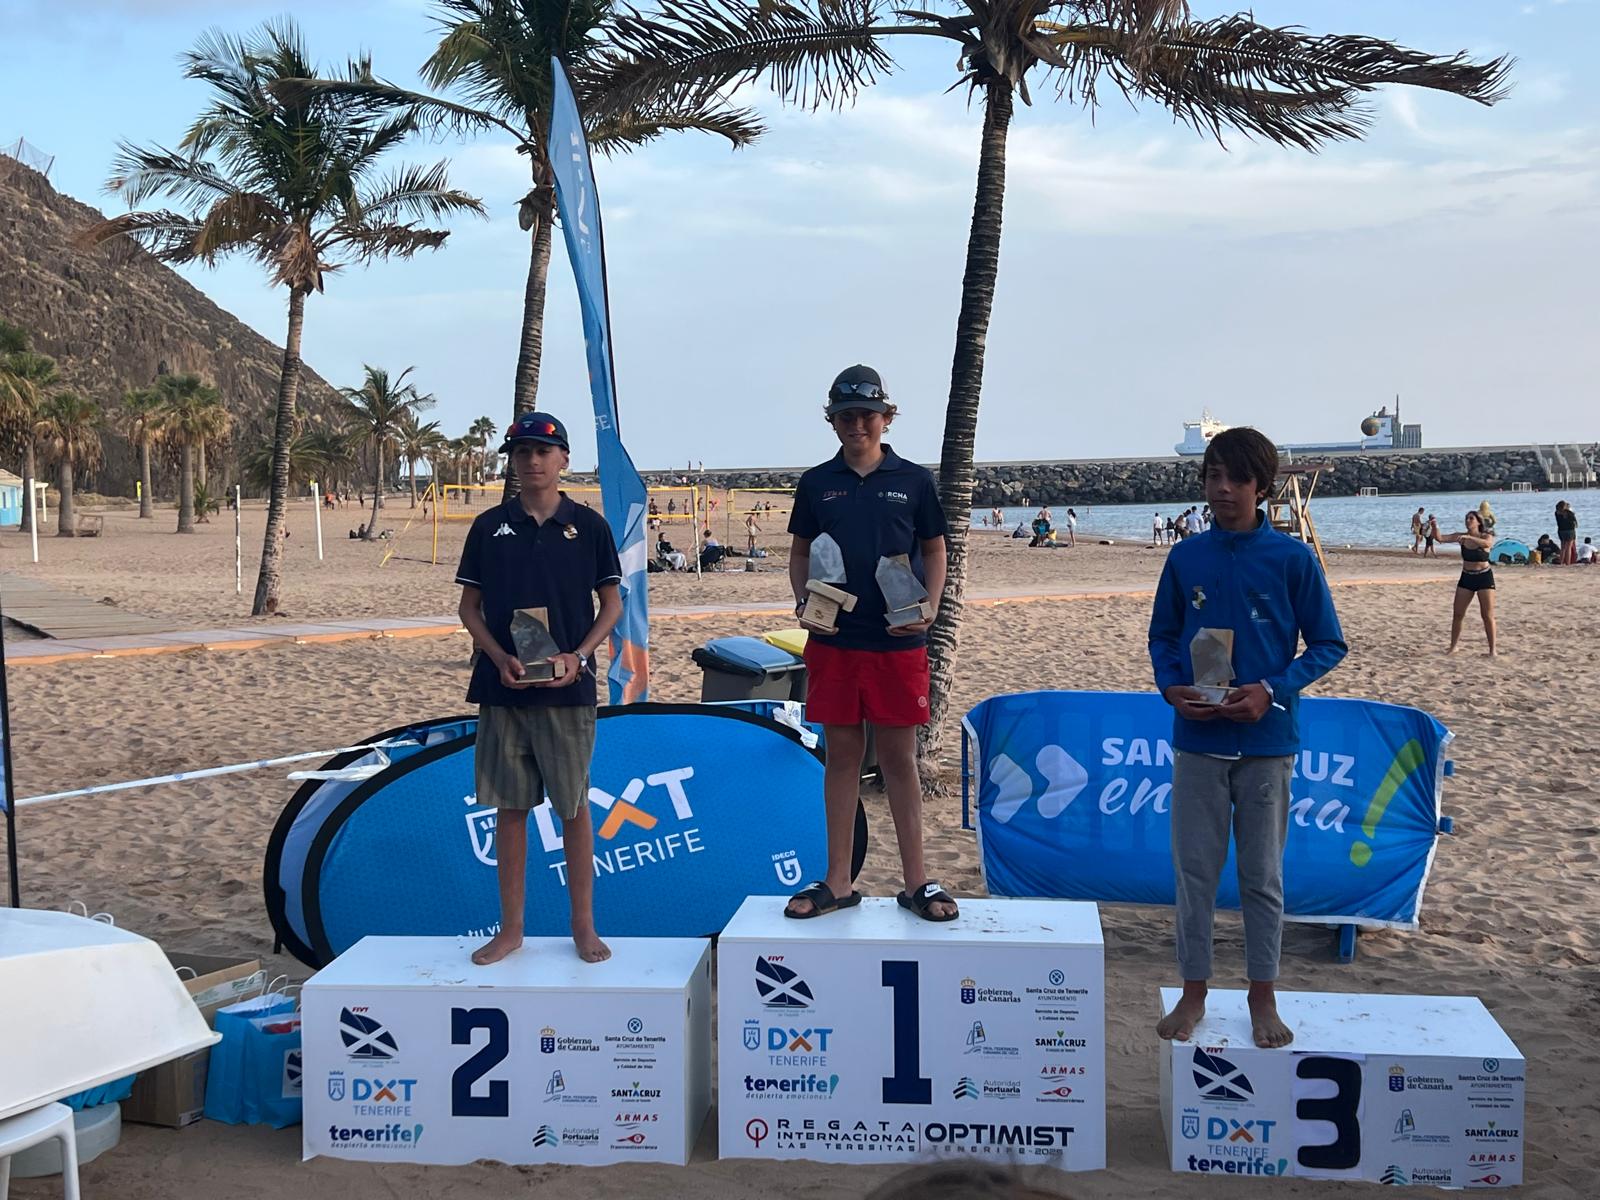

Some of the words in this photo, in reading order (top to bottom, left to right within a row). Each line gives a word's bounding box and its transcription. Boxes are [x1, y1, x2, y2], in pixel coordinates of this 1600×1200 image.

[1102, 737, 1174, 767] SAN
[1099, 777, 1173, 816] en
[549, 828, 705, 886] TNERIFE
[772, 850, 796, 861] IDECO
[978, 988, 1013, 996] Gobierno
[988, 995, 1021, 1003] Canarias
[882, 960, 932, 1105] 1
[557, 1037, 592, 1045] Gobierno
[768, 1027, 833, 1052] DXT
[567, 1044, 600, 1052] Canarias
[451, 1007, 509, 1117] 2
[768, 1055, 827, 1067] TENERIFE
[1041, 1066, 1085, 1074] ARMAS
[1407, 1075, 1444, 1084] Gobierno
[352, 1078, 418, 1102] DXT
[1418, 1083, 1453, 1091] Canarias
[353, 1105, 412, 1117] TENERIFE
[615, 1113, 659, 1121] ARMAS
[1296, 1056, 1362, 1169] 3
[777, 1118, 915, 1132] REGATA
[1207, 1117, 1276, 1144] DXT
[777, 1131, 915, 1143] INTERNACIONAL
[925, 1122, 1075, 1147] OPTIMIST
[825, 1142, 915, 1152] TERESITAS
[1207, 1144, 1269, 1159] TENERIFE
[1469, 1154, 1516, 1162] ARMAS
